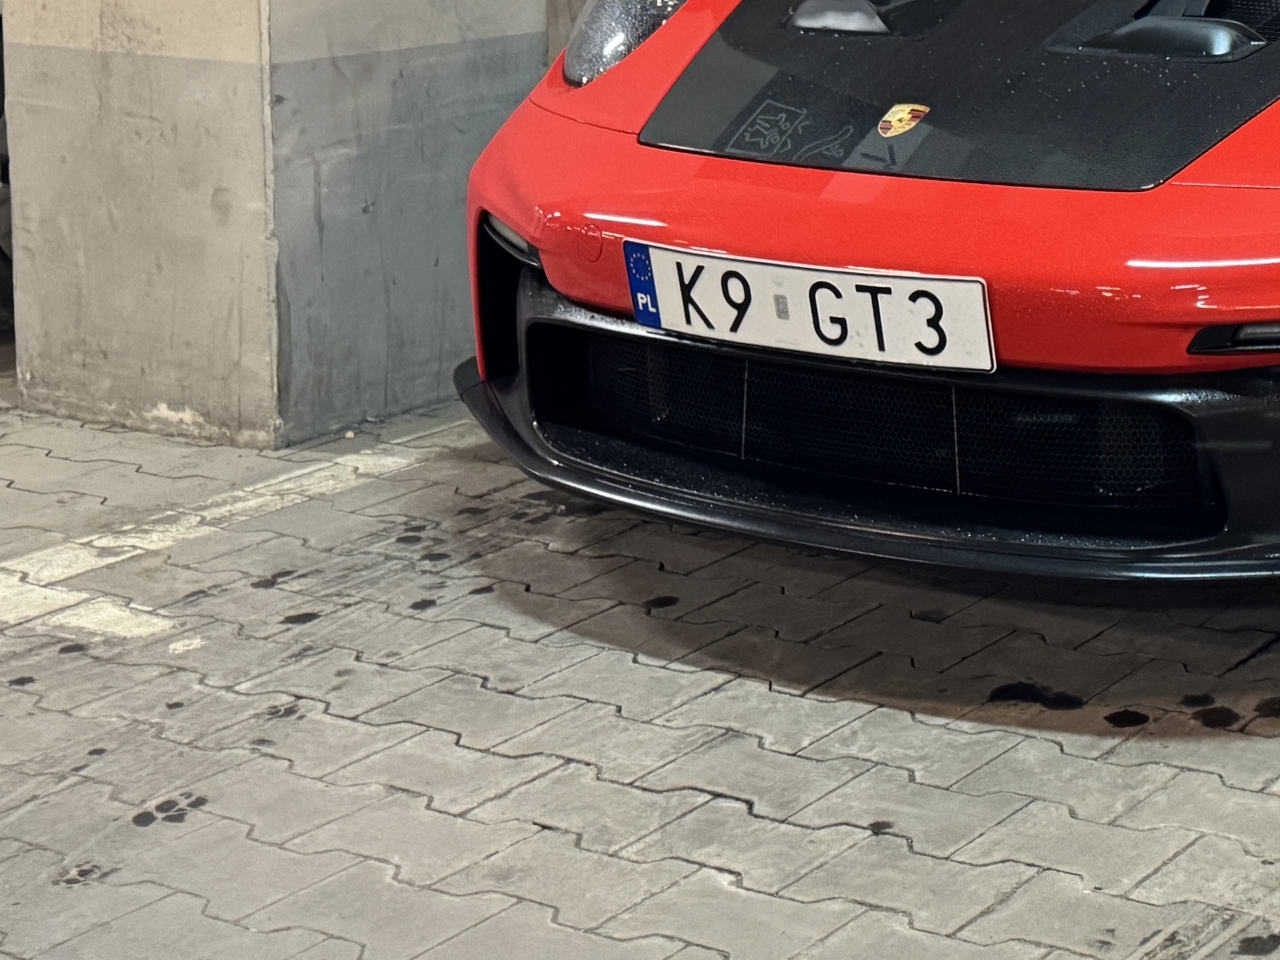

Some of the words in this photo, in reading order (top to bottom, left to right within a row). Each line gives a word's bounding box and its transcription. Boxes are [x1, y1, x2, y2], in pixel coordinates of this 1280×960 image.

[636, 292, 657, 313] PL
[675, 261, 752, 333] K9
[808, 280, 947, 356] GT3
